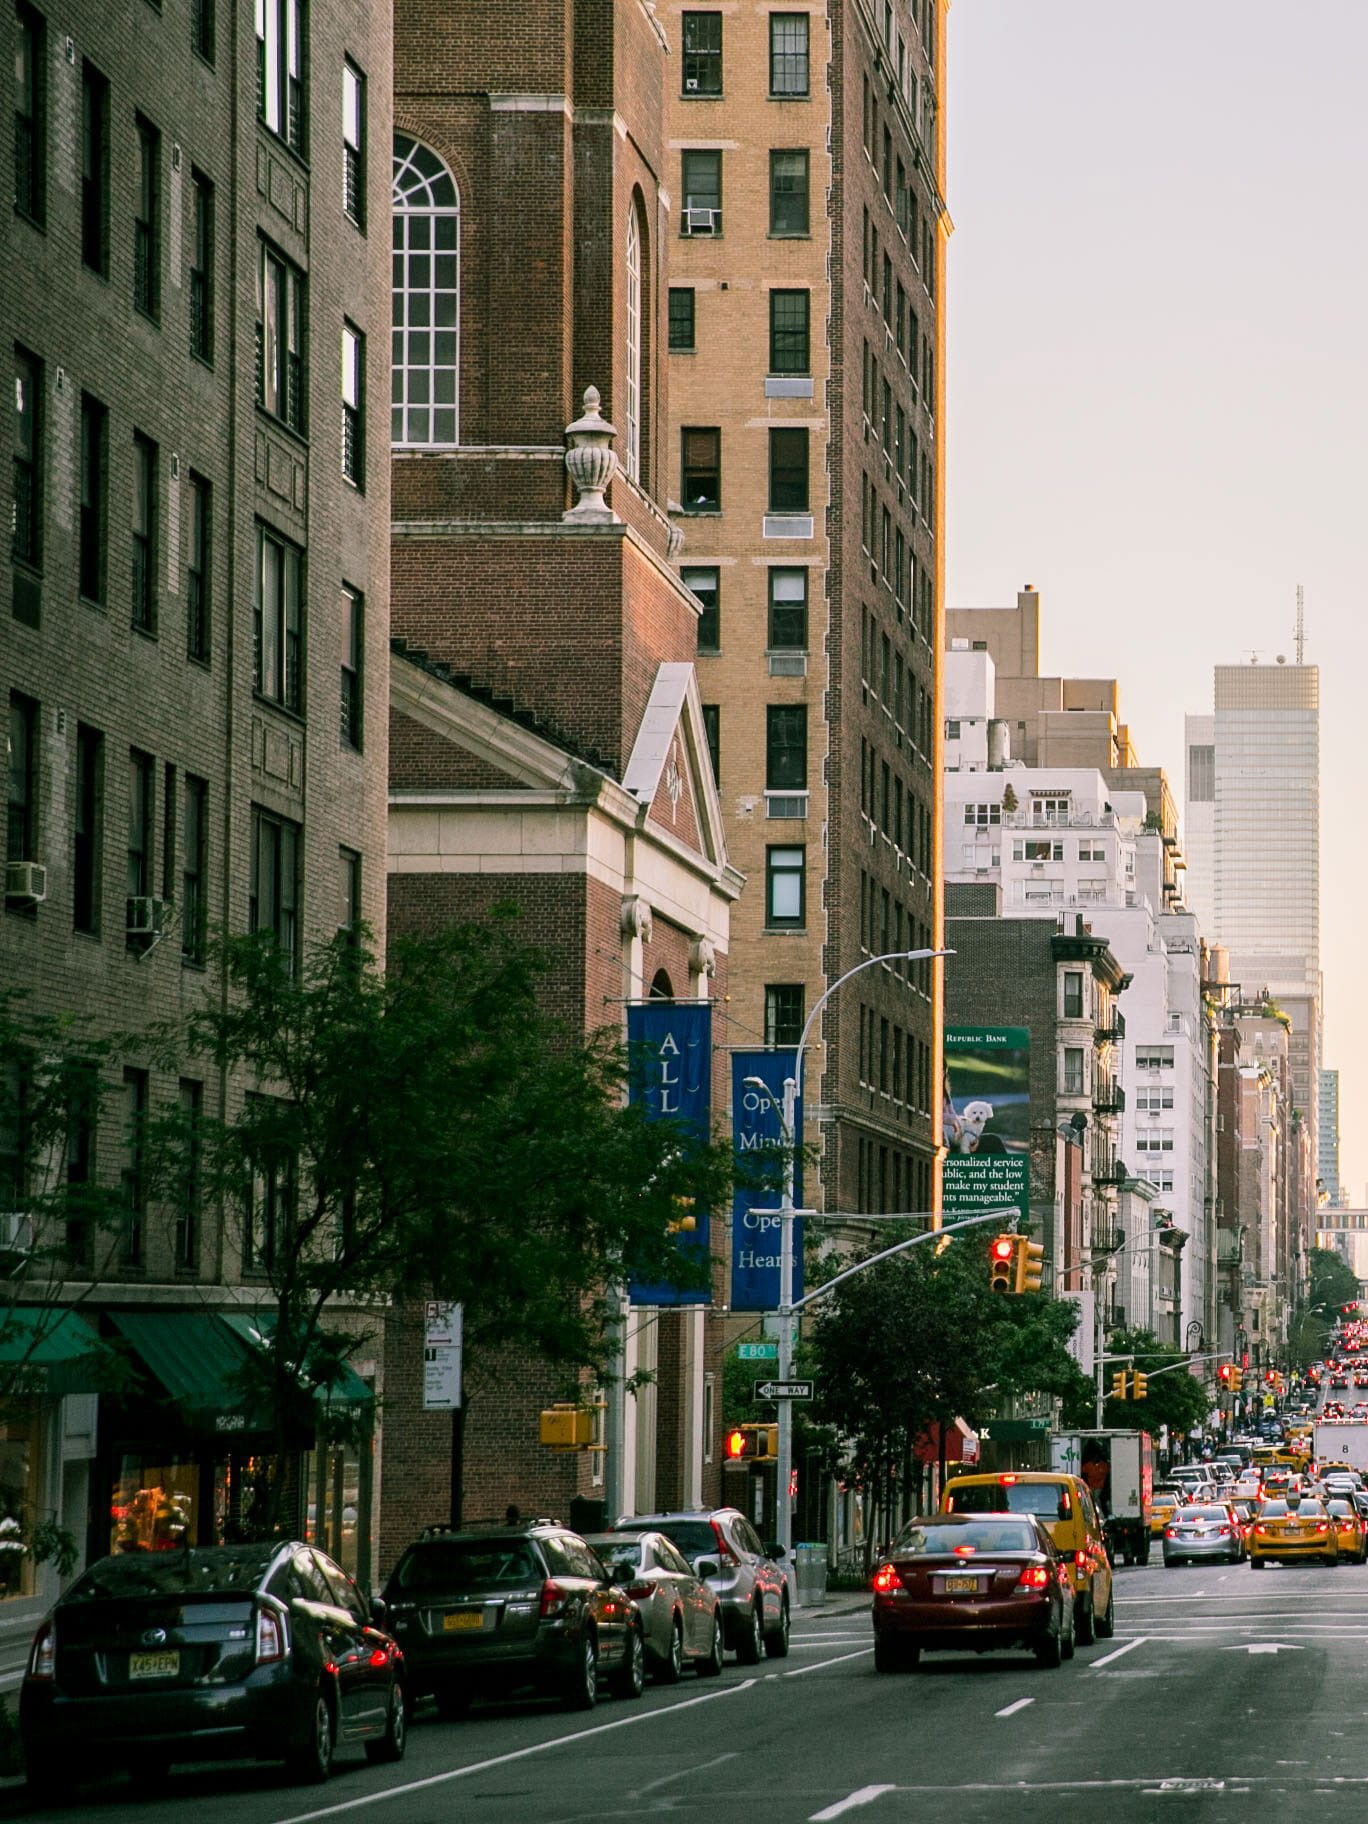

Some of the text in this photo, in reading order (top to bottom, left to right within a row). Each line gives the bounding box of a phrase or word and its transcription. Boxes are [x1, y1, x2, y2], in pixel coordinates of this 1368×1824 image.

[658, 1032, 680, 1112] ALL
[743, 1092, 785, 1114] Ope
[942, 1157, 1024, 1167] ersonalized service
[968, 1168, 986, 1178] and
[989, 1169, 1004, 1178] the
[1006, 1168, 1023, 1178] low
[946, 1180, 1024, 1192] make my student
[743, 1211, 781, 1232] Ope
[740, 1346, 747, 1357] E
[750, 1345, 766, 1357] 80
[763, 1386, 805, 1395] ONE WAY
[1342, 1445, 1349, 1453] 8
